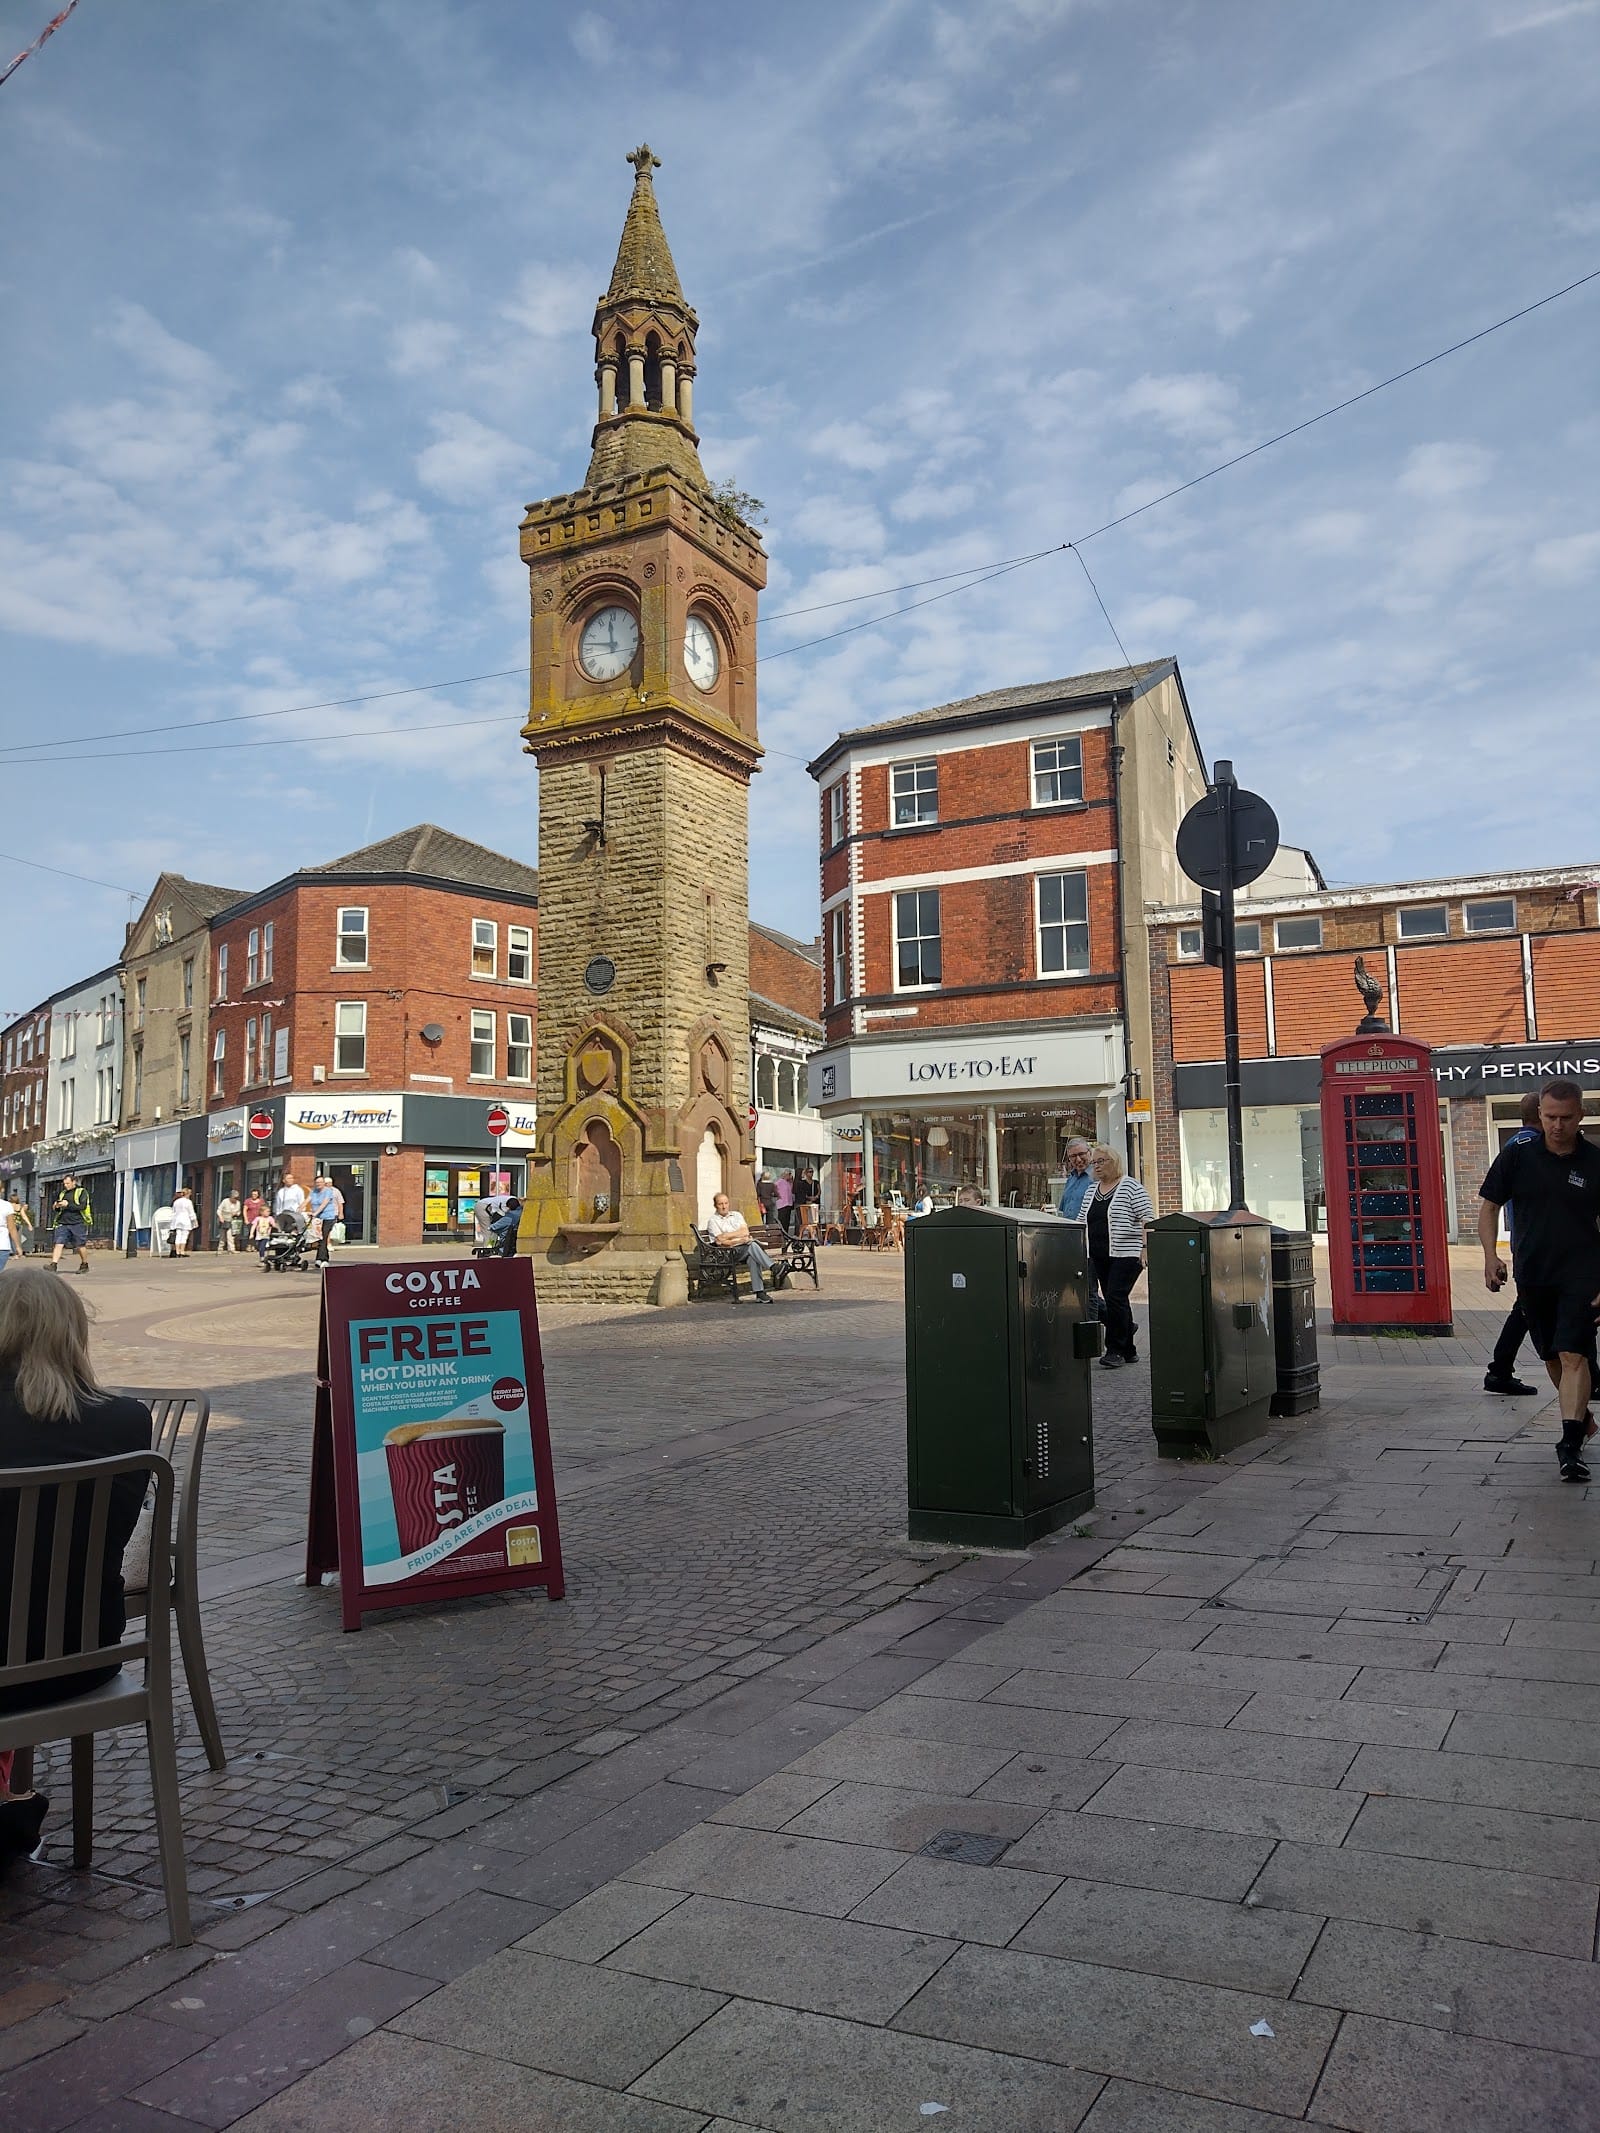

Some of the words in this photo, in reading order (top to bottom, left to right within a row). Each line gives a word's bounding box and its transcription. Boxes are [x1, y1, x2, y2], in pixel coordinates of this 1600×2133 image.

[908, 1062, 956, 1082] LOVE
[965, 1059, 993, 1077] TO
[1000, 1056, 1038, 1076] EAT
[1339, 1060, 1416, 1072] TELEPHONE
[1432, 1066, 1472, 1081] HY
[1481, 1058, 1600, 1079] PERKINS
[298, 1110, 338, 1127] Hays
[342, 1109, 392, 1125] Travel
[515, 1117, 535, 1128] Ha
[385, 1269, 481, 1294] COSTA
[409, 1296, 462, 1308] COFFEE
[359, 1320, 491, 1364] FREE
[360, 1366, 399, 1381] HOT
[402, 1362, 457, 1379] DRINK
[361, 1383, 393, 1393] WHEN
[394, 1380, 417, 1390] YOU
[417, 1378, 438, 1388] BUY
[439, 1377, 460, 1386] ANY
[362, 1400, 381, 1408] COSTA
[427, 1400, 454, 1408] VOUCHER
[407, 1539, 453, 1570] FRIDAYS
[453, 1526, 475, 1543] ARE
[476, 1519, 485, 1527] A
[484, 1508, 504, 1523] BIG
[505, 1497, 535, 1513] DEAL
[511, 1537, 537, 1547] COSTA
